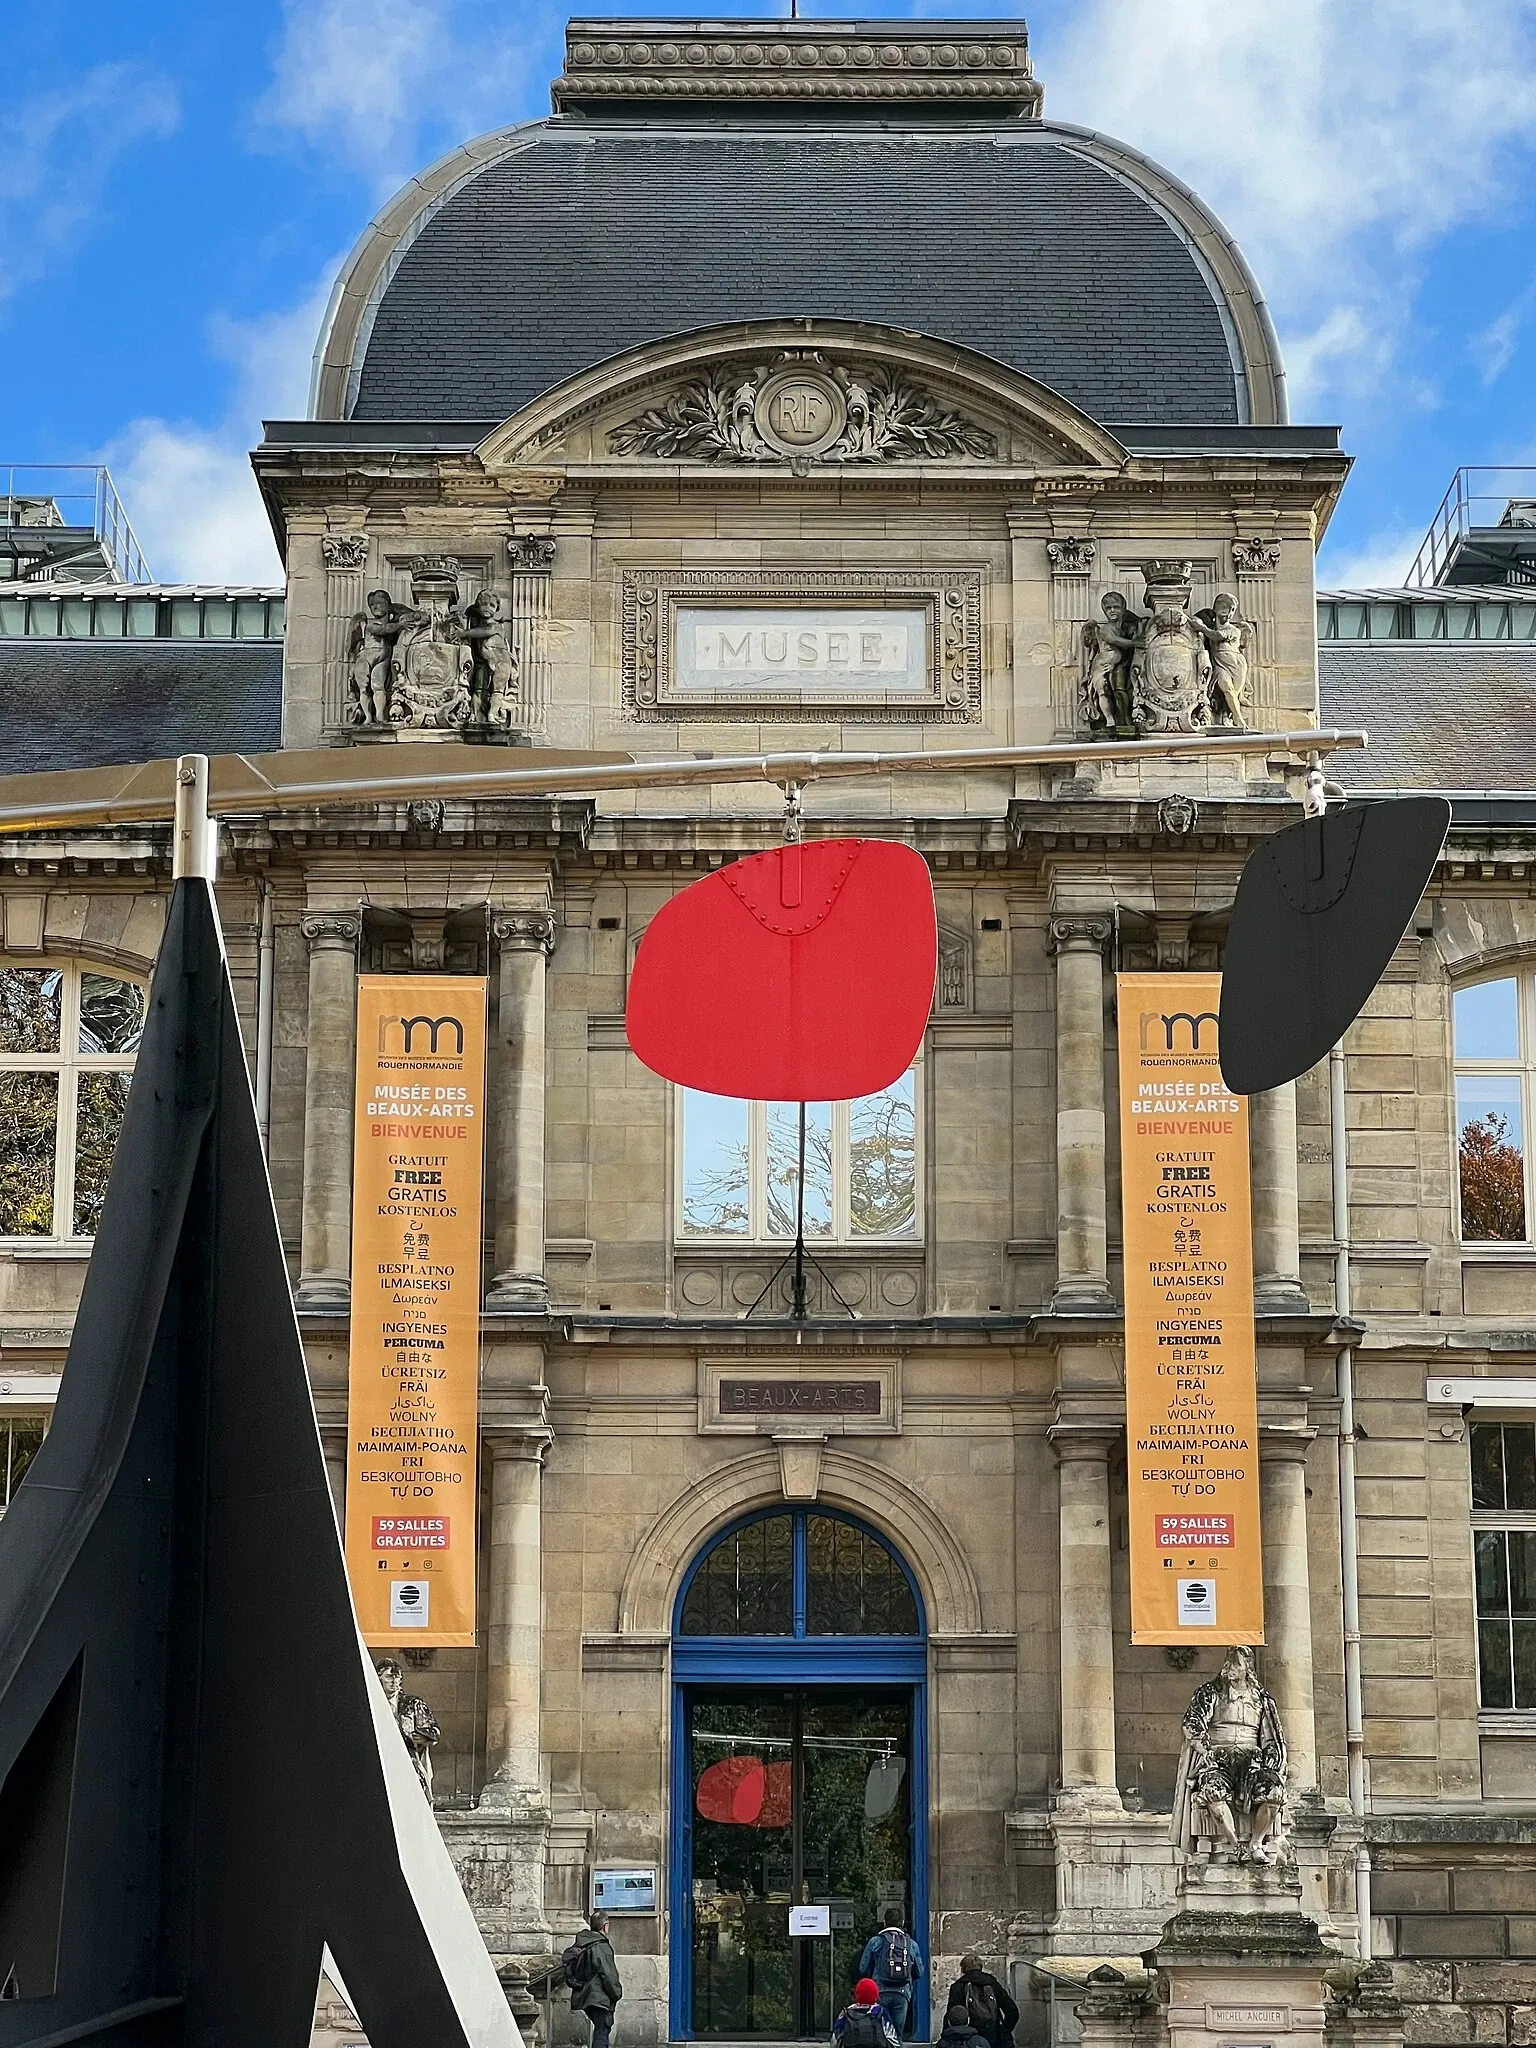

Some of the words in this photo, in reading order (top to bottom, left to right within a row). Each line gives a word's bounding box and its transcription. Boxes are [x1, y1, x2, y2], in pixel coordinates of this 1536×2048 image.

[777, 395, 823, 433] RF
[375, 1084, 430, 1100] MUSÉE
[435, 1087, 467, 1100] DES
[1139, 1080, 1195, 1096] MUSÉE
[367, 1103, 474, 1117] BEAUX-ARTS
[1131, 1099, 1239, 1113] BEAUX-ARTS
[371, 1124, 467, 1139] BIENVENUE
[1137, 1121, 1233, 1134] BIENVENUE
[388, 1155, 448, 1166] GRATUIT
[1155, 1152, 1215, 1162] GRATUIT
[394, 1170, 442, 1184] FREE
[1162, 1167, 1209, 1180] FREE
[388, 1188, 447, 1202] GRATIS
[1157, 1184, 1216, 1198] GRATIS
[377, 1206, 457, 1217] KOSTENLOS
[1147, 1202, 1227, 1213] KOSTENLOS
[403, 1233, 430, 1246] 免费
[1173, 1229, 1201, 1243] 免费
[403, 1247, 430, 1261] 무료
[1174, 1244, 1202, 1257] 무료
[377, 1264, 455, 1276] BESPLATNO
[1149, 1261, 1227, 1272] BESPLATNO
[381, 1279, 451, 1290] ILMAISEKSI
[1153, 1275, 1224, 1286] ILMAISEKSI
[392, 1293, 438, 1305] Δωρεάν
[1165, 1290, 1212, 1303] Δωρεάν
[382, 1323, 447, 1335] INGYENES
[1156, 1320, 1223, 1331] INGYENES
[383, 1338, 445, 1349] PERCUMA
[1158, 1336, 1221, 1346] PERCUMA
[396, 1351, 432, 1363] 自由な
[1172, 1348, 1210, 1360] 自由な
[381, 1365, 447, 1379] ÜCRETSIZ
[1157, 1363, 1225, 1376] ÜCRETSIZ
[399, 1380, 428, 1392] FRÄI
[1177, 1377, 1205, 1390] FRÄI
[734, 1388, 866, 1406] BEAUX-ARTS
[390, 1412, 436, 1423] WOLNY
[1167, 1409, 1215, 1420] WOLNY
[371, 1427, 454, 1438] БЕСПЛАТНО
[1150, 1424, 1235, 1436] БЕСПЛАТНО
[357, 1442, 467, 1454] MAIMAIM-POANA
[1137, 1439, 1248, 1450] MAIMAIM-POANA
[402, 1457, 424, 1467] FRI
[1182, 1455, 1204, 1465] FRI
[361, 1471, 462, 1483] БЕЗКОШТОВНО
[1142, 1469, 1245, 1481] БЕЗКОШТОВНО
[413, 1486, 434, 1497] DO
[1194, 1484, 1215, 1495] DO
[379, 1520, 394, 1531] 59
[397, 1520, 444, 1531] SALLES
[1162, 1518, 1177, 1529] 59
[1180, 1518, 1227, 1529] SALLES
[376, 1535, 446, 1547] GRATUITES
[1160, 1533, 1229, 1545] GRATUITES
[1217, 2012, 1242, 2021] MICHEL
